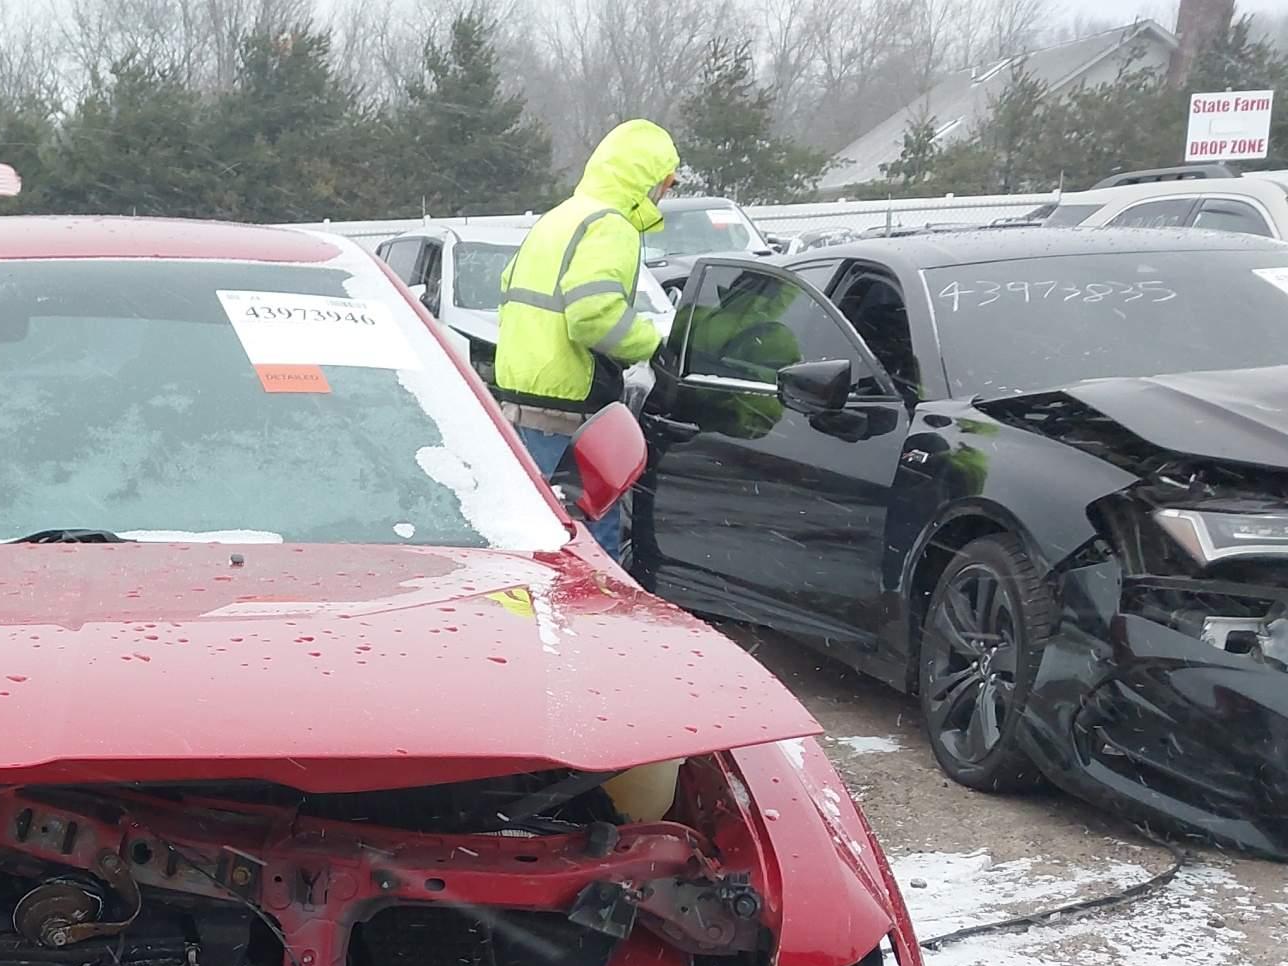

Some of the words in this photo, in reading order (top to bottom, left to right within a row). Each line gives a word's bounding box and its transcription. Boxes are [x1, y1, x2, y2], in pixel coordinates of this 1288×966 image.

[1192, 98, 1230, 114] State
[1233, 97, 1270, 113] Farm
[1189, 140, 1227, 156] DROP
[1230, 139, 1265, 154] ZONE
[938, 280, 1178, 313] 43973835
[245, 305, 376, 327] 43973946
